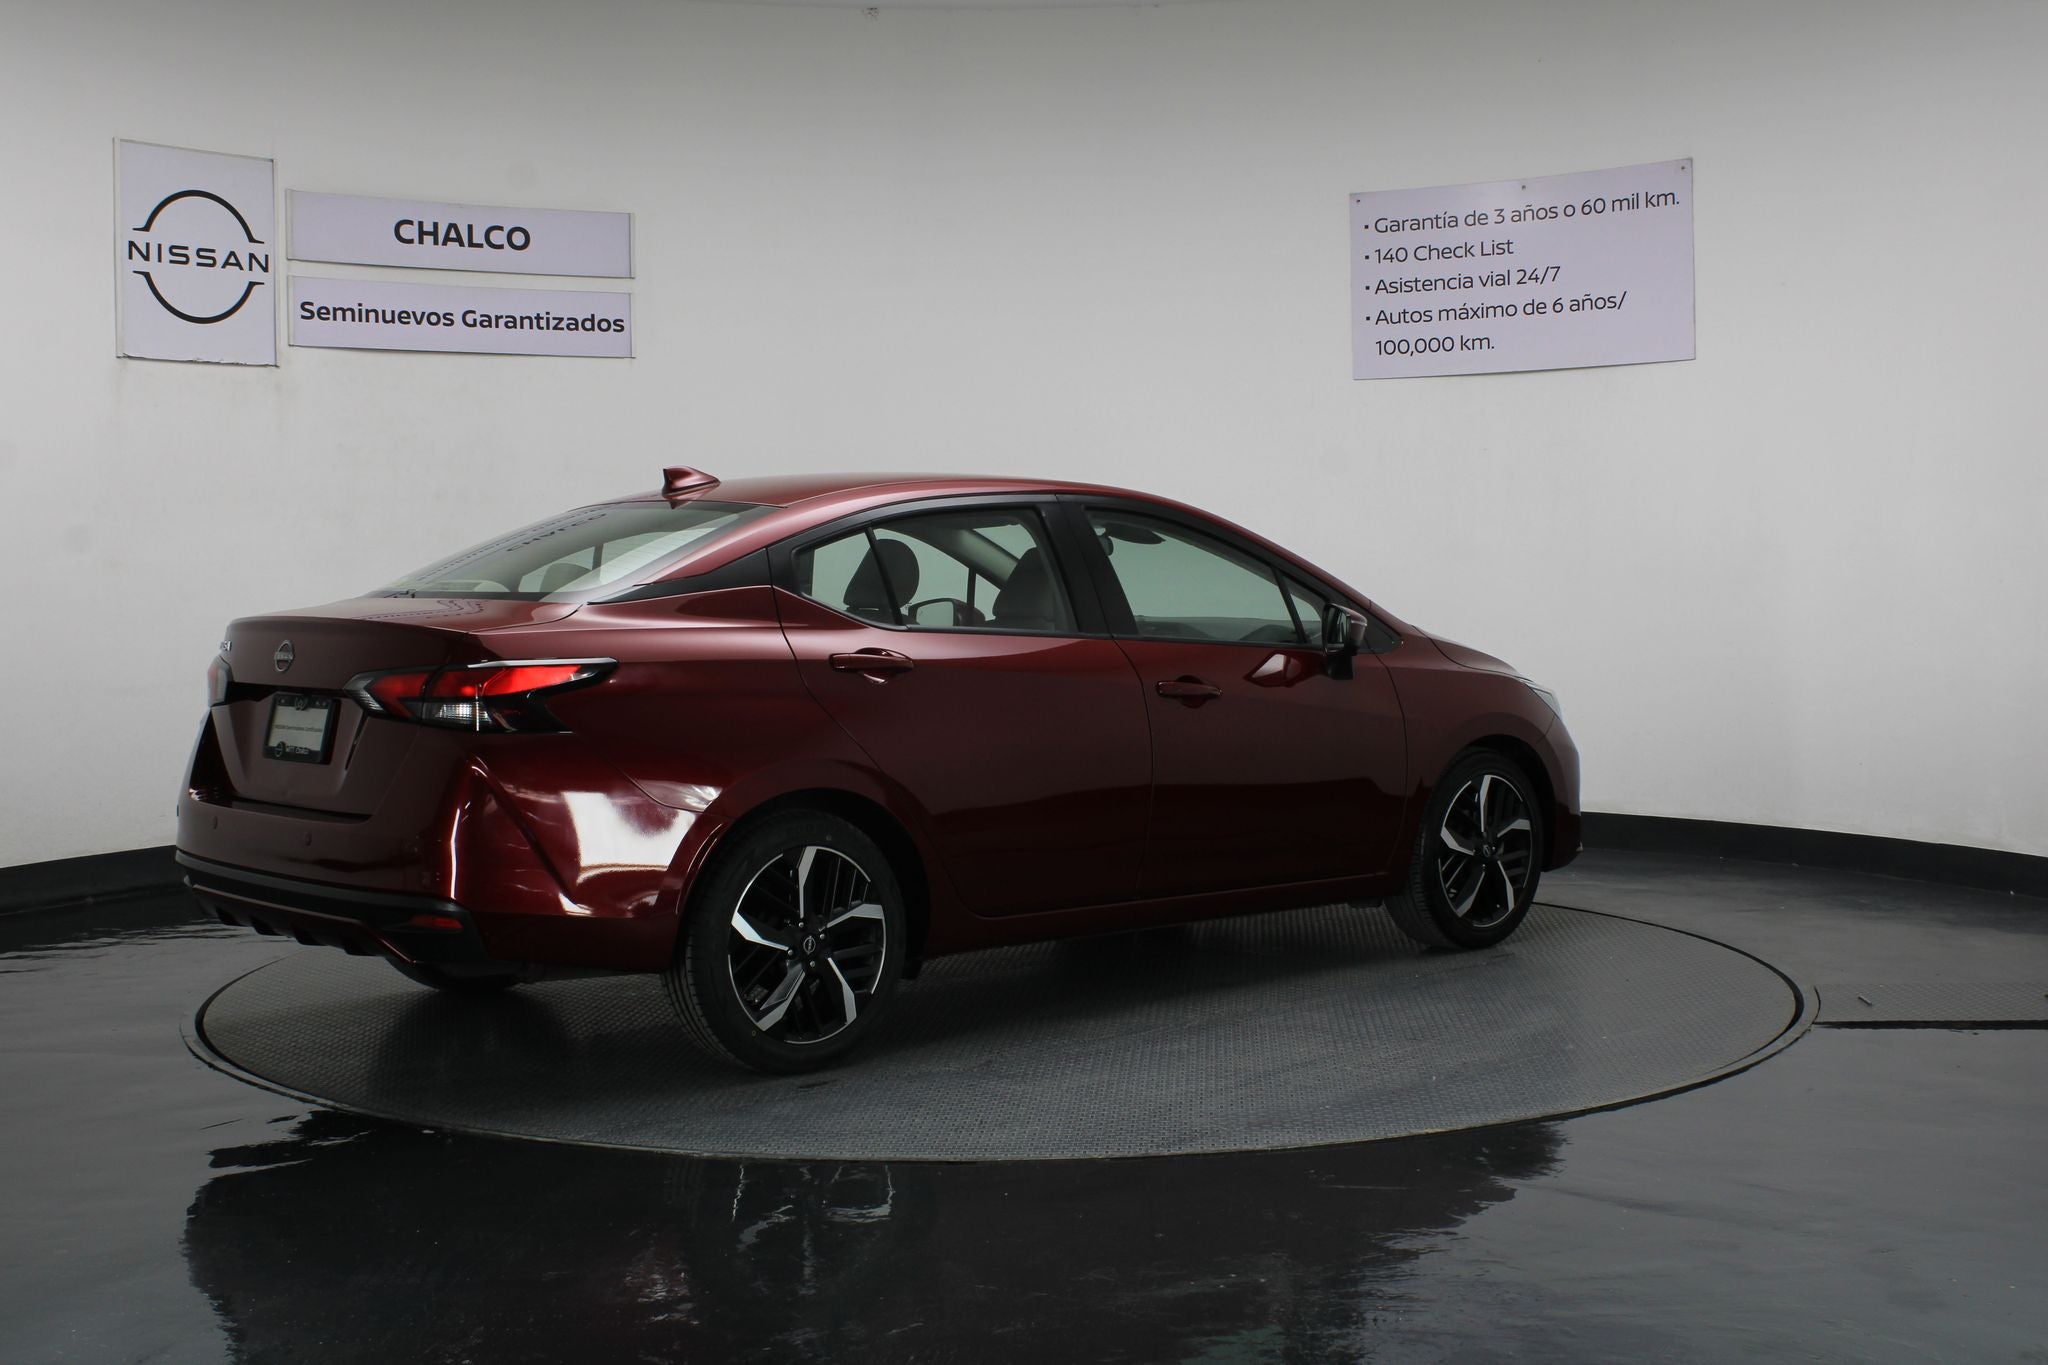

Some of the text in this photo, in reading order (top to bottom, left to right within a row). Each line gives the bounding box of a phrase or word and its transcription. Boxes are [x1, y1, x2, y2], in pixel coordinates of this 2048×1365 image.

[1374, 191, 1680, 234] Garantía de 3 años o 60 mil km.
[393, 218, 531, 252] CHALCO
[1374, 239, 1515, 265] 140 Check List
[127, 239, 270, 274] NISSAN
[1374, 265, 1561, 295] Asistencia vial 24/7
[299, 300, 626, 334] Seminuevos Garantizados
[1374, 290, 1628, 326] Autos máximo de 6 años/
[1374, 334, 1496, 357] 100,000 km.
